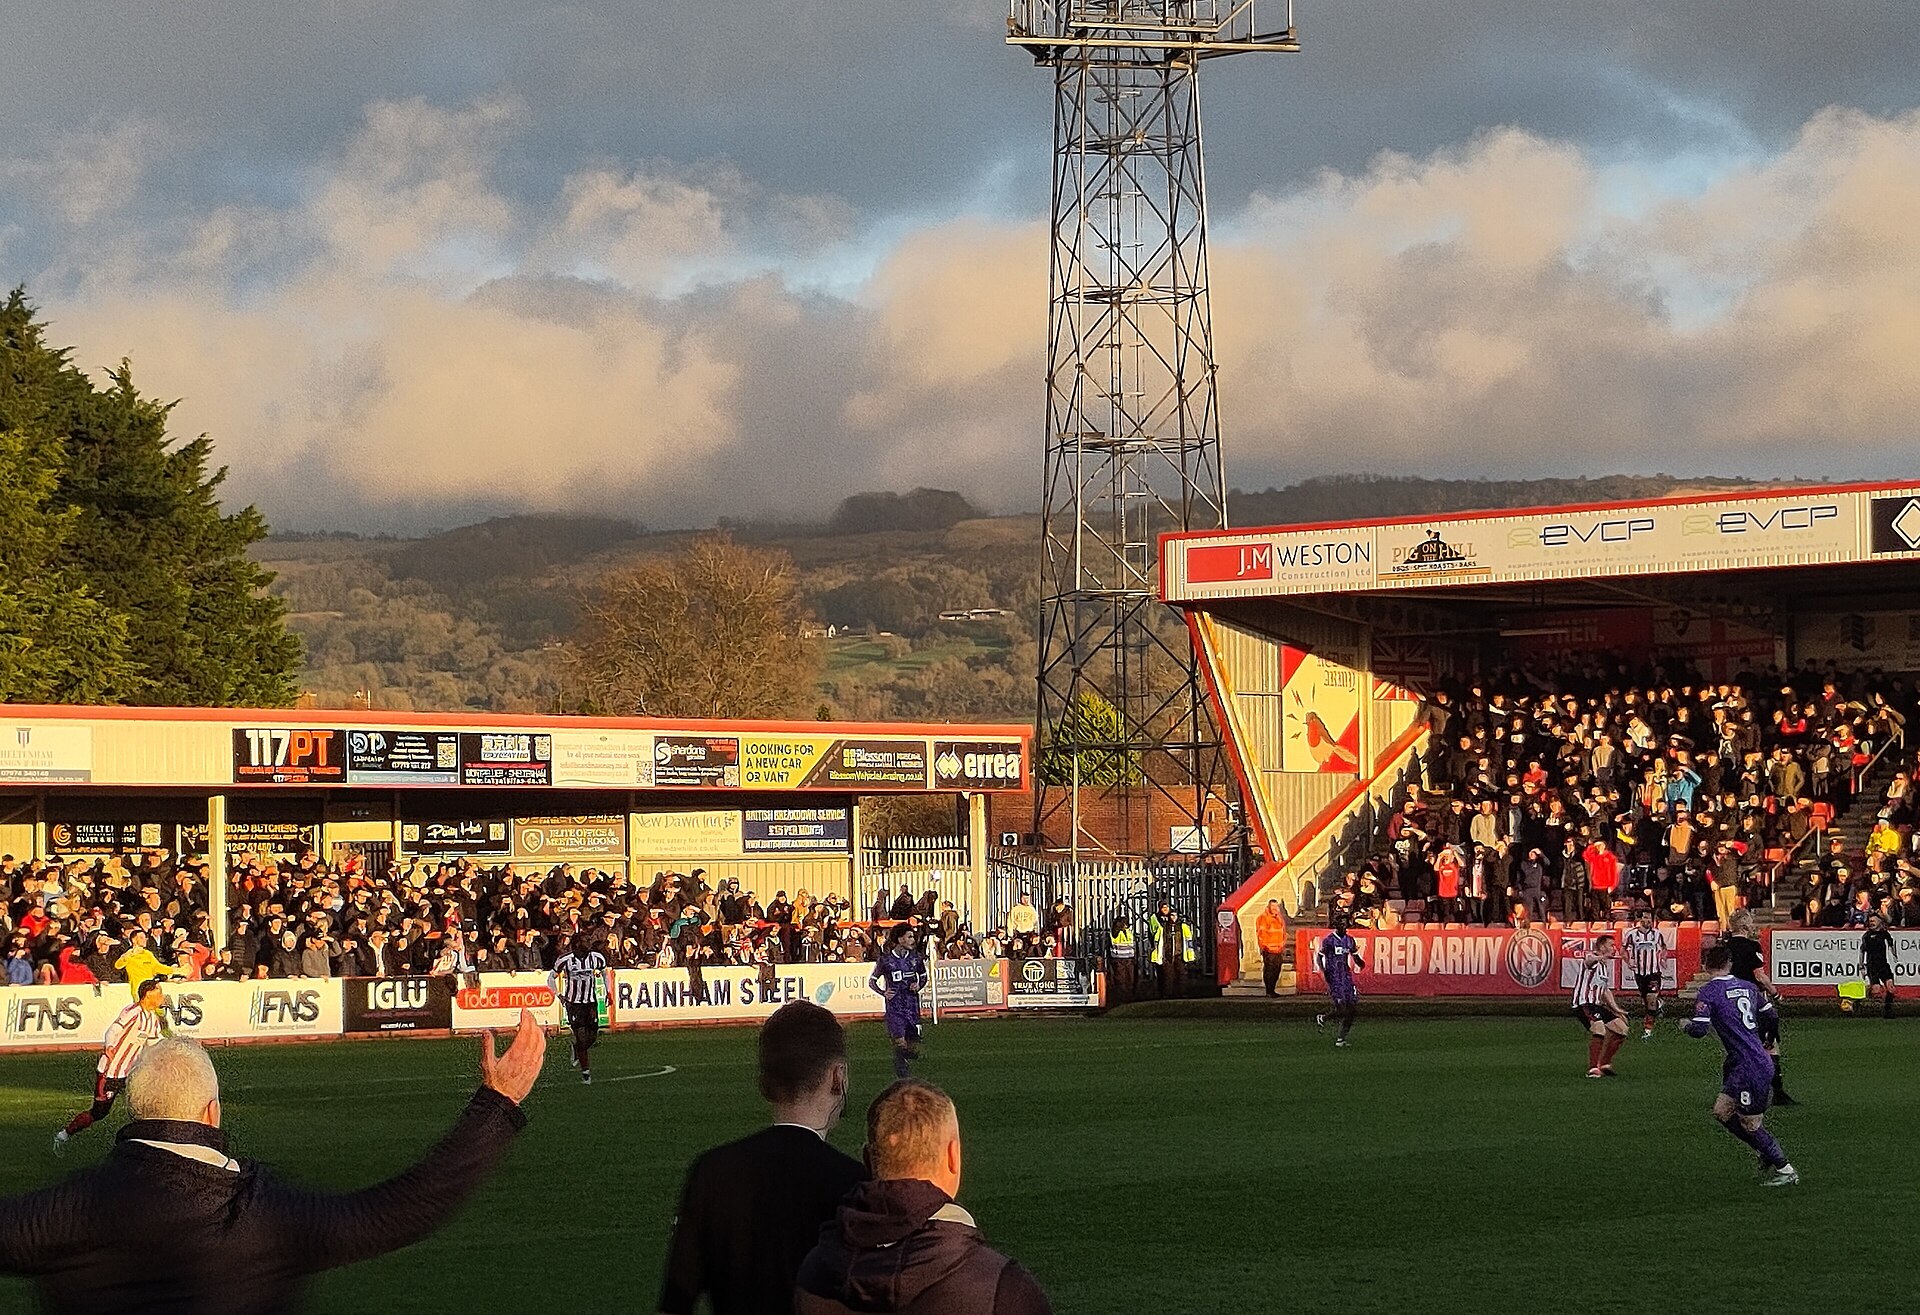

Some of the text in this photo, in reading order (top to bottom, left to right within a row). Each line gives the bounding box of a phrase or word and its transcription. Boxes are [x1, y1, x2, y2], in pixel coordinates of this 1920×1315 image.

[1392, 543, 1478, 562] PIG HILL
[1422, 543, 1437, 553] ON
[1237, 541, 1370, 576] J.M WESTON
[1277, 568, 1371, 581] (Construction) Ltd
[0, 750, 53, 759] HELTENHAM
[245, 729, 334, 767] 117PT
[745, 743, 792, 755] LOOKING
[794, 744, 814, 755] FOR
[746, 757, 802, 769] A NEW CAR
[746, 771, 789, 782] OR VAN?
[665, 814, 700, 828] Dawn
[703, 814, 721, 828] Inn
[251, 824, 298, 833] BUTCHERS
[607, 828, 615, 837] &
[587, 837, 620, 846] ROOMS
[1776, 939, 1809, 950] EVERY
[1813, 939, 1846, 950] GAME
[1374, 935, 1504, 975] RED ARMY
[1778, 962, 1822, 978] BBC
[1825, 963, 1859, 976] RADI
[508, 991, 554, 1007] move
[163, 993, 204, 1026] NS
[261, 990, 320, 1023] FNS
[1737, 996, 1757, 1030] 8
[19, 997, 83, 1031] FNS
[1740, 1091, 1750, 1105] 8
